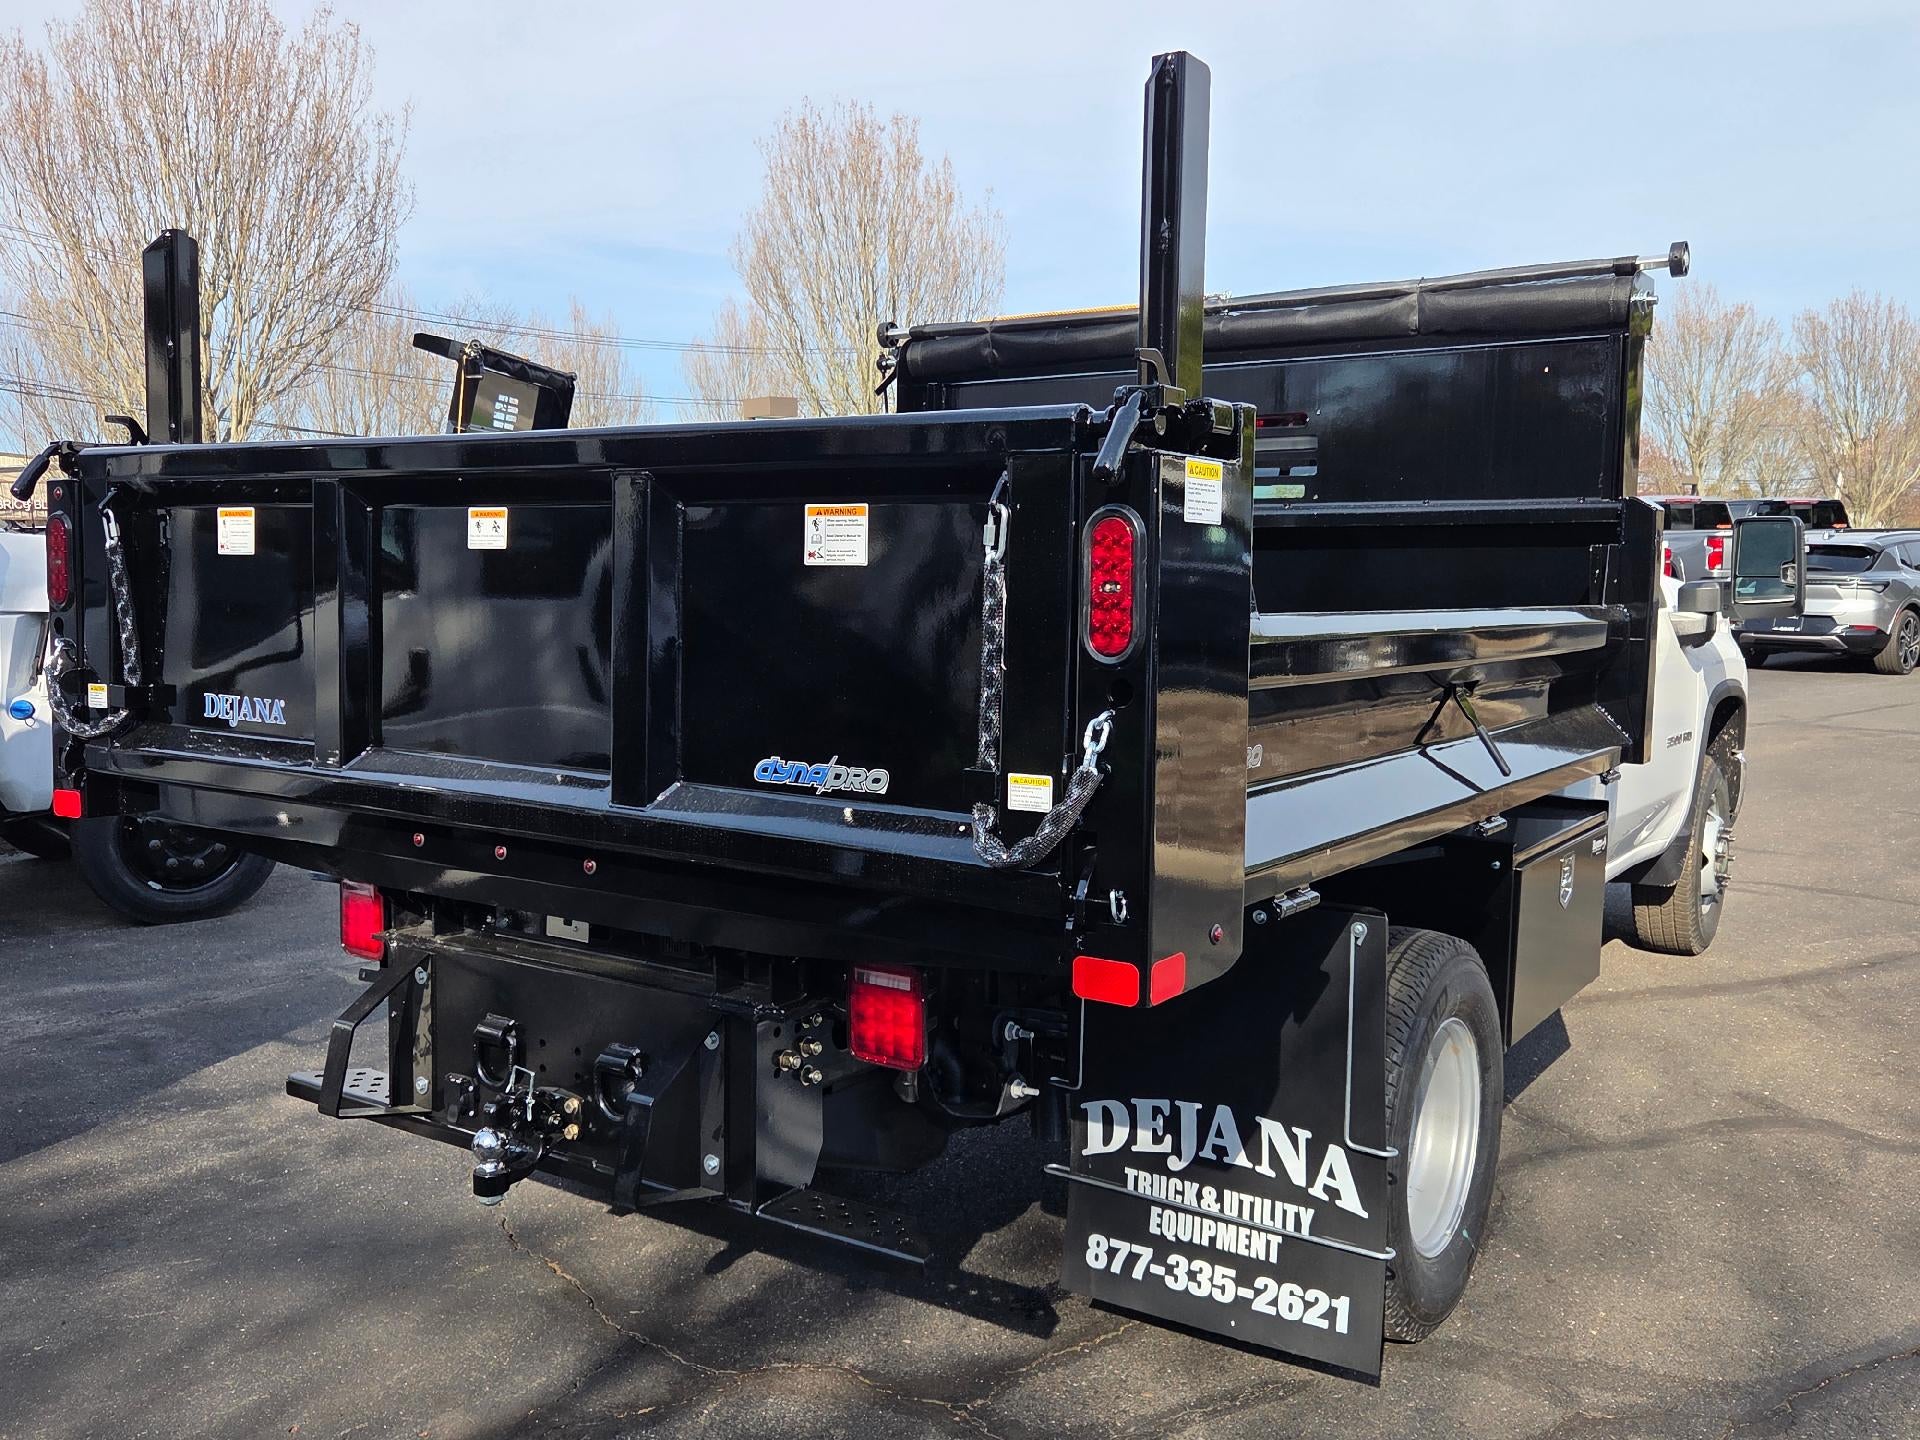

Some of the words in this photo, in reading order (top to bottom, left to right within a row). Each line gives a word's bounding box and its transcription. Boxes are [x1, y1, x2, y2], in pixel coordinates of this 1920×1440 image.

[1194, 466, 1219, 478] CAUTION
[823, 508, 857, 516] WARNING
[203, 692, 287, 728] DEJANA
[1019, 778, 1047, 786] CAUTION
[1080, 1098, 1369, 1219] DEJANA
[1148, 1206, 1283, 1265] EQUIPMENT
[1085, 1233, 1351, 1335] 877-335-2621
